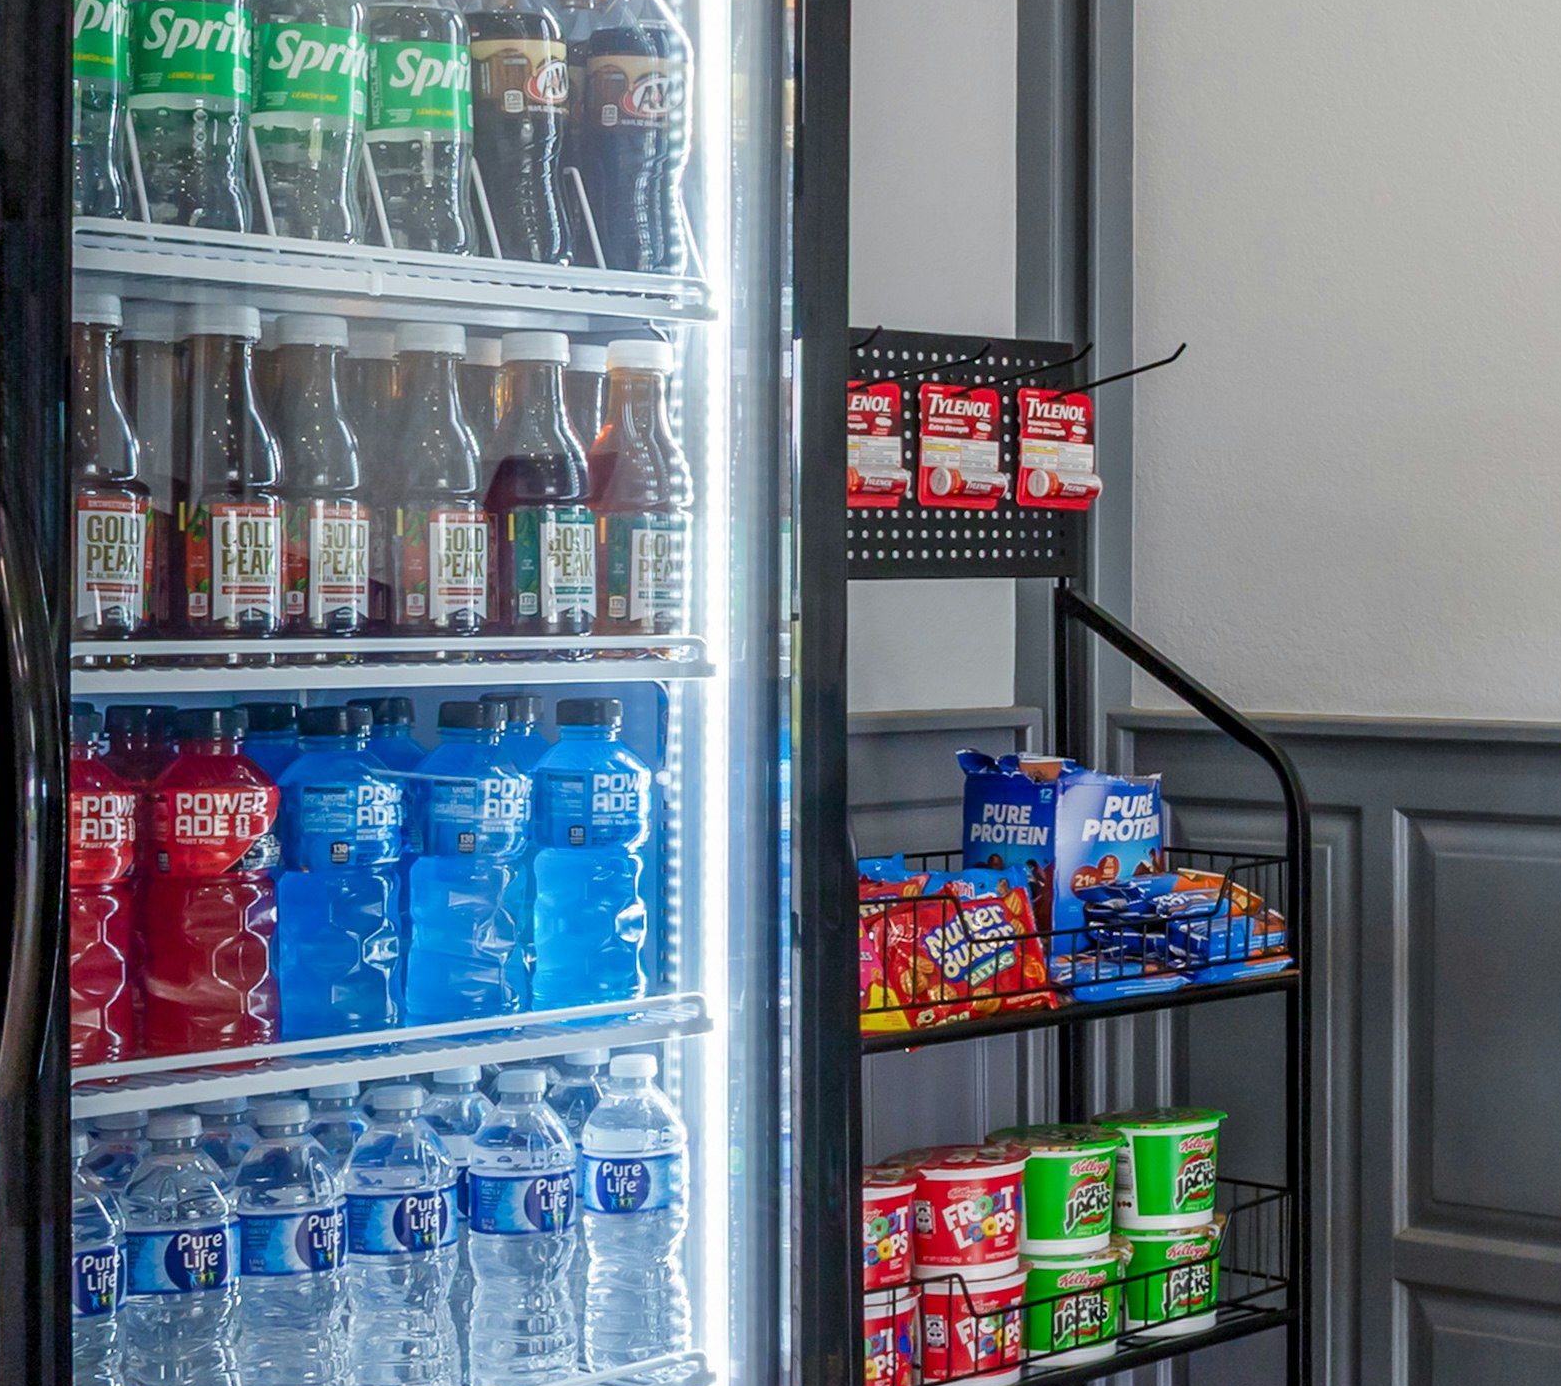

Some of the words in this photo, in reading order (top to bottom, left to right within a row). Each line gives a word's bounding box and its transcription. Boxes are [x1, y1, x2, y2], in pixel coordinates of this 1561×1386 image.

[928, 393, 992, 418] TYLENOL
[1026, 397, 1087, 423] TYLENOL
[175, 792, 269, 815] POWER
[592, 793, 637, 814] ADE
[983, 802, 1032, 825] PURE
[1103, 791, 1154, 820] PURE
[175, 814, 230, 837] ADE
[970, 823, 1049, 847] PROTEIN
[1081, 815, 1160, 844] PROTEIN
[331, 843, 349, 855] 130
[459, 833, 475, 845] 130
[601, 1159, 643, 1178] Pure
[534, 1176, 571, 1197] Pure
[606, 1176, 638, 1197] Life
[405, 1192, 443, 1215] Pure
[540, 1192, 568, 1214] Life
[942, 1185, 1015, 1232] FROOT
[307, 1212, 344, 1233] Pure
[411, 1210, 440, 1232] Life
[953, 1209, 1016, 1250] LOOPS
[177, 1230, 223, 1253] Pure
[312, 1230, 342, 1251] Life
[81, 1251, 121, 1275] Pure
[183, 1249, 220, 1273] Life
[87, 1269, 118, 1295] Life
